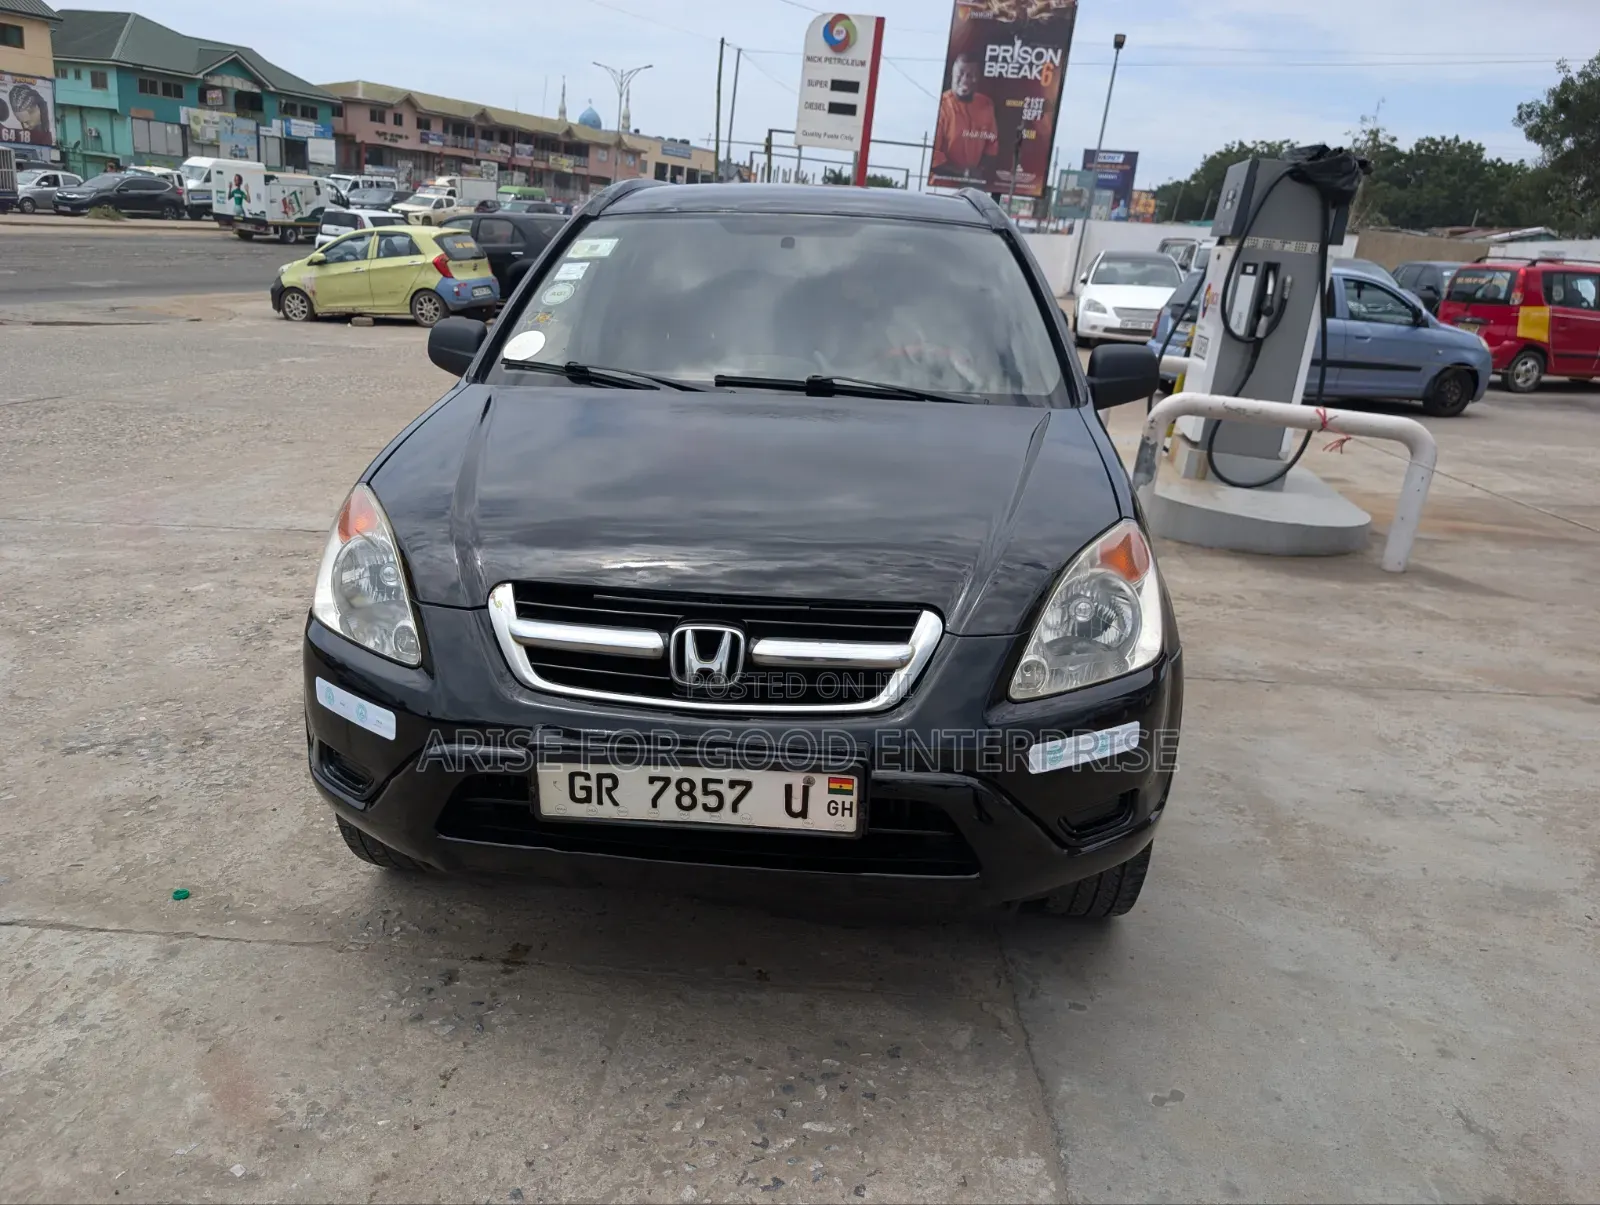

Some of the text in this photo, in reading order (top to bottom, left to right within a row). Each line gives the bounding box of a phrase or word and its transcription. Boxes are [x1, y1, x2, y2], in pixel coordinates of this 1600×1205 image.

[985, 37, 1062, 66] PRISON
[806, 55, 867, 67] NICK PETROLEUM
[984, 60, 1054, 87] BREAK 6
[807, 79, 829, 89] SUPER
[804, 101, 826, 111] DIESEL
[1024, 96, 1045, 110] 21ST
[1022, 109, 1043, 121] SEPT
[1, 128, 31, 143] 64 18
[802, 130, 822, 139] Quality
[568, 771, 810, 819] GR 7857 U
[827, 799, 854, 817] GH
